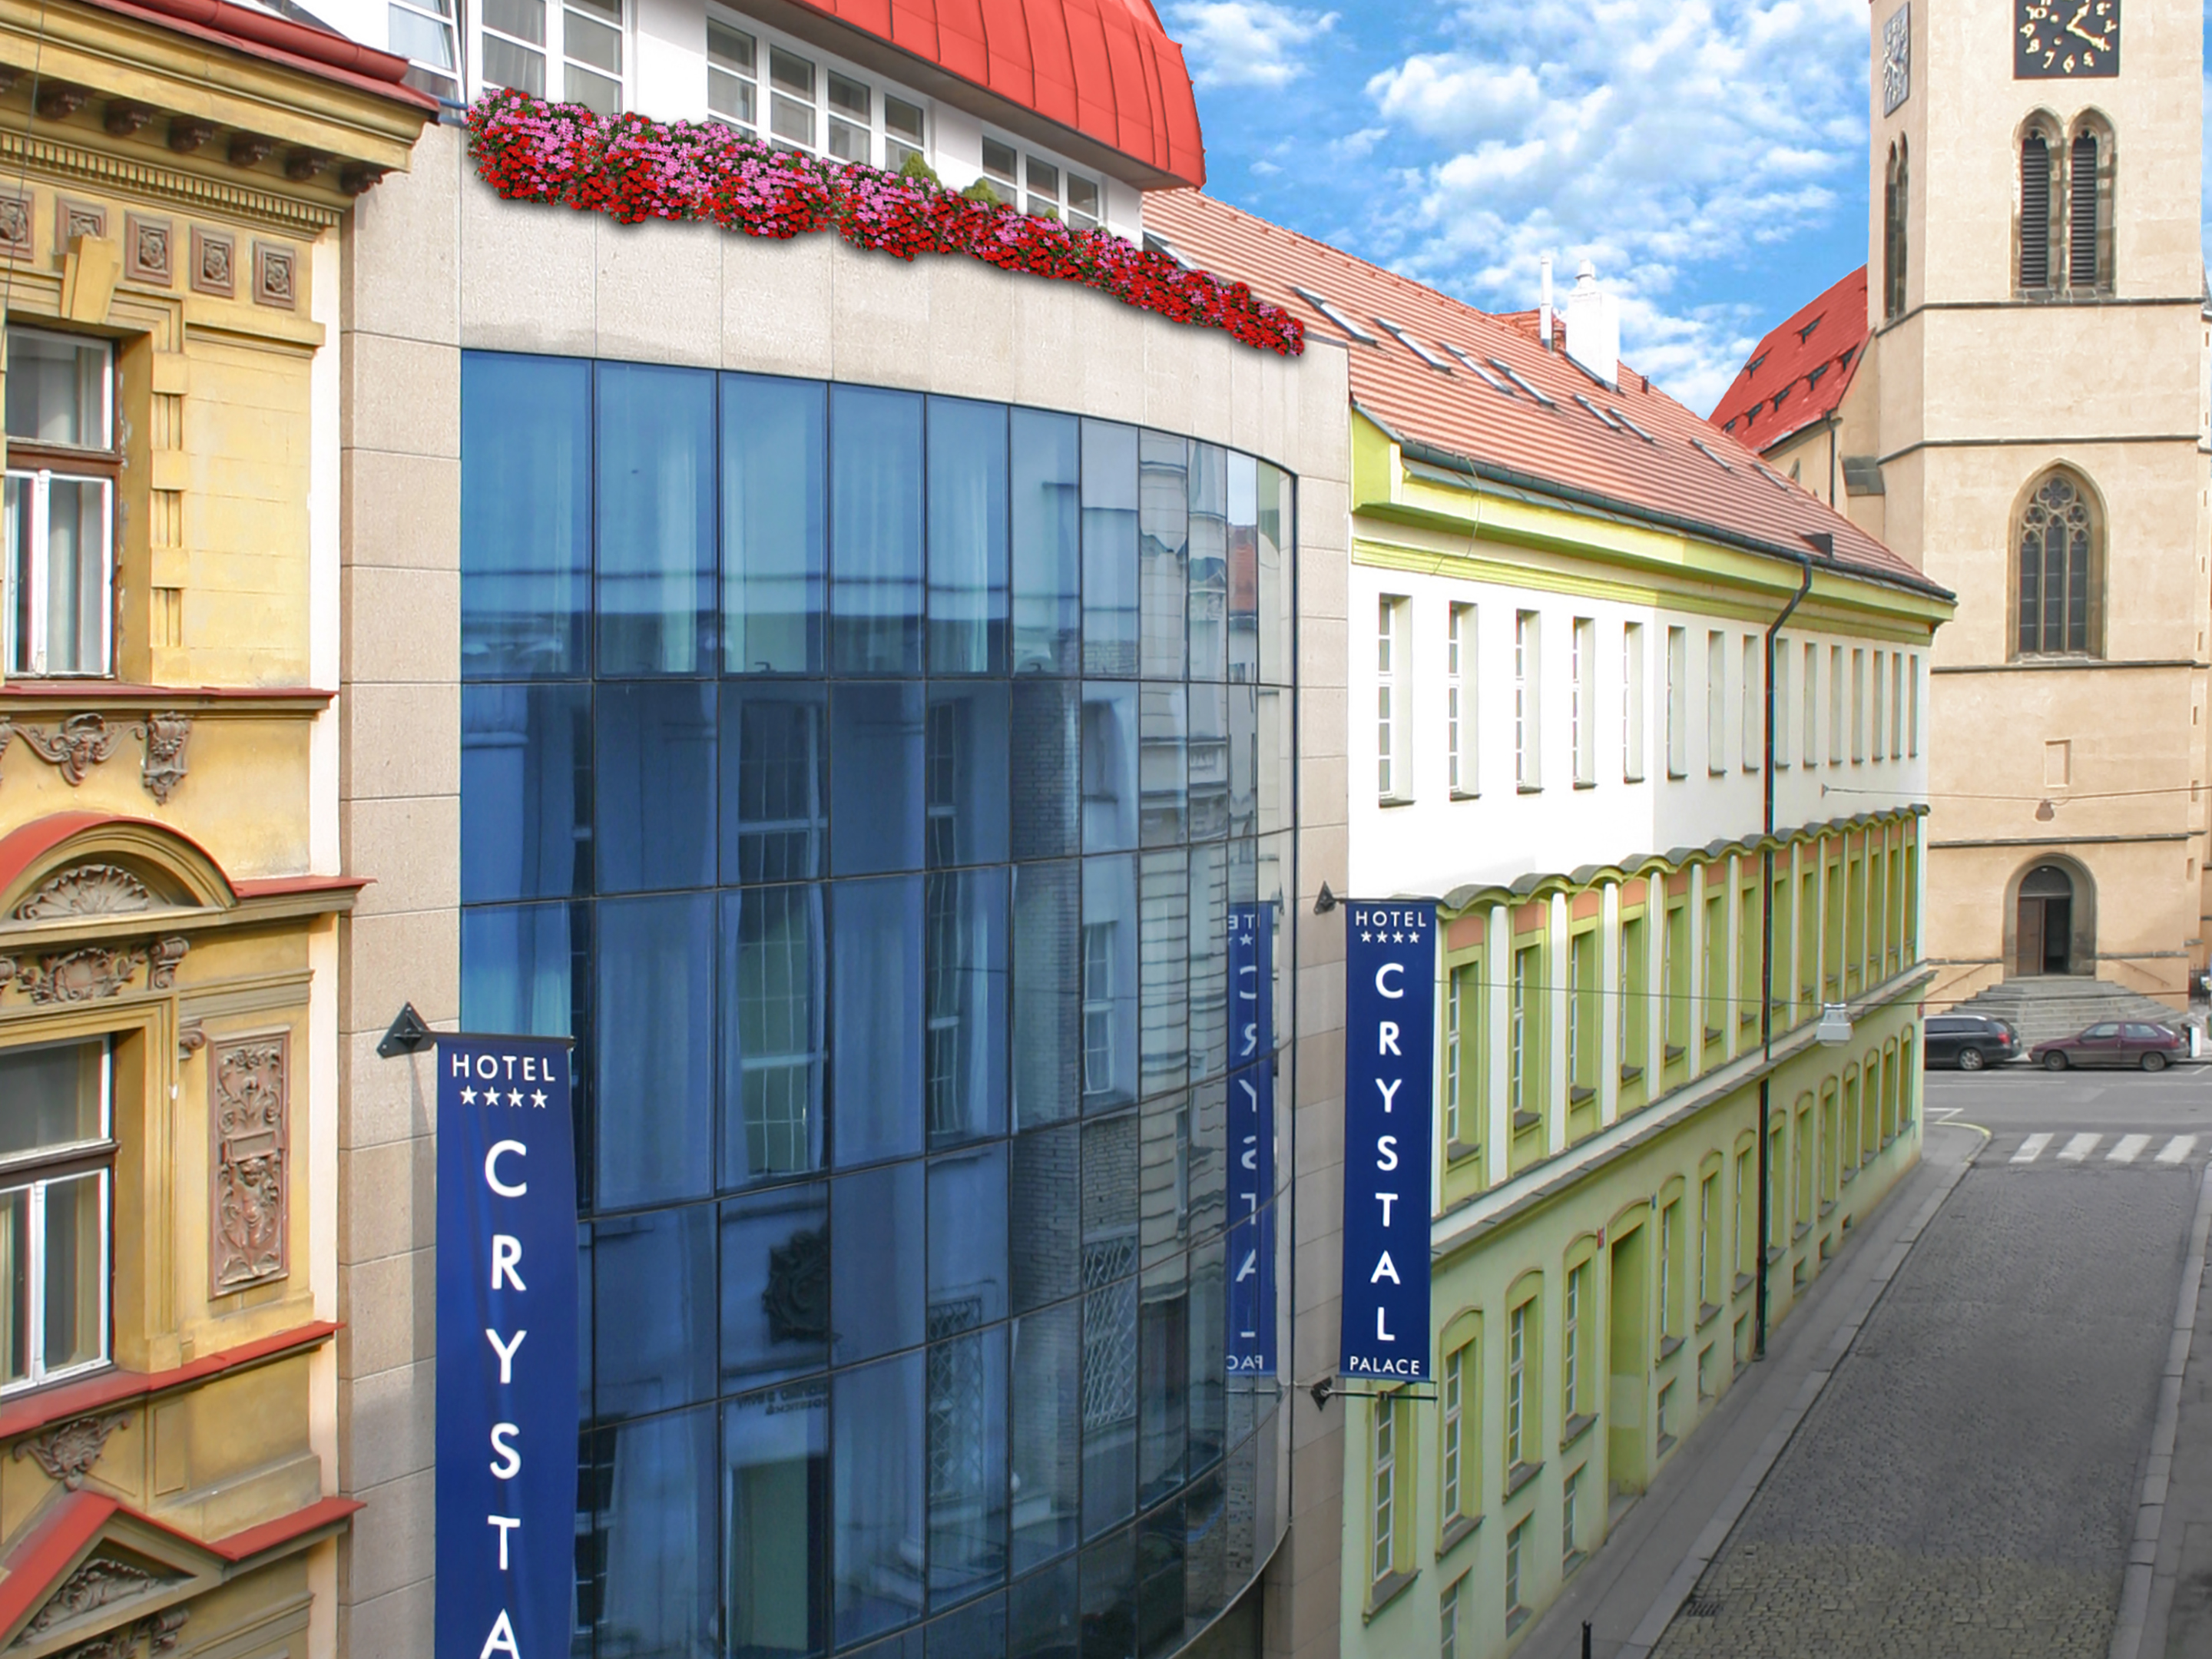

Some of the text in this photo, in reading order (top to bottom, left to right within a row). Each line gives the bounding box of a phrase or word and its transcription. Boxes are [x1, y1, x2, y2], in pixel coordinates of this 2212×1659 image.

[2025, 5, 2048, 20] 10
[2019, 22, 2035, 38] 9
[2025, 38, 2040, 54] 8
[2043, 50, 2055, 68] 7
[2062, 54, 2075, 73] 6
[1355, 910, 1426, 927] HOTEL
[452, 1053, 555, 1081] HOTEL
[1370, 962, 1405, 1342] CRYSTAL
[1349, 1356, 1420, 1375] PALACE
[479, 1138, 528, 1659] CRYSTA
